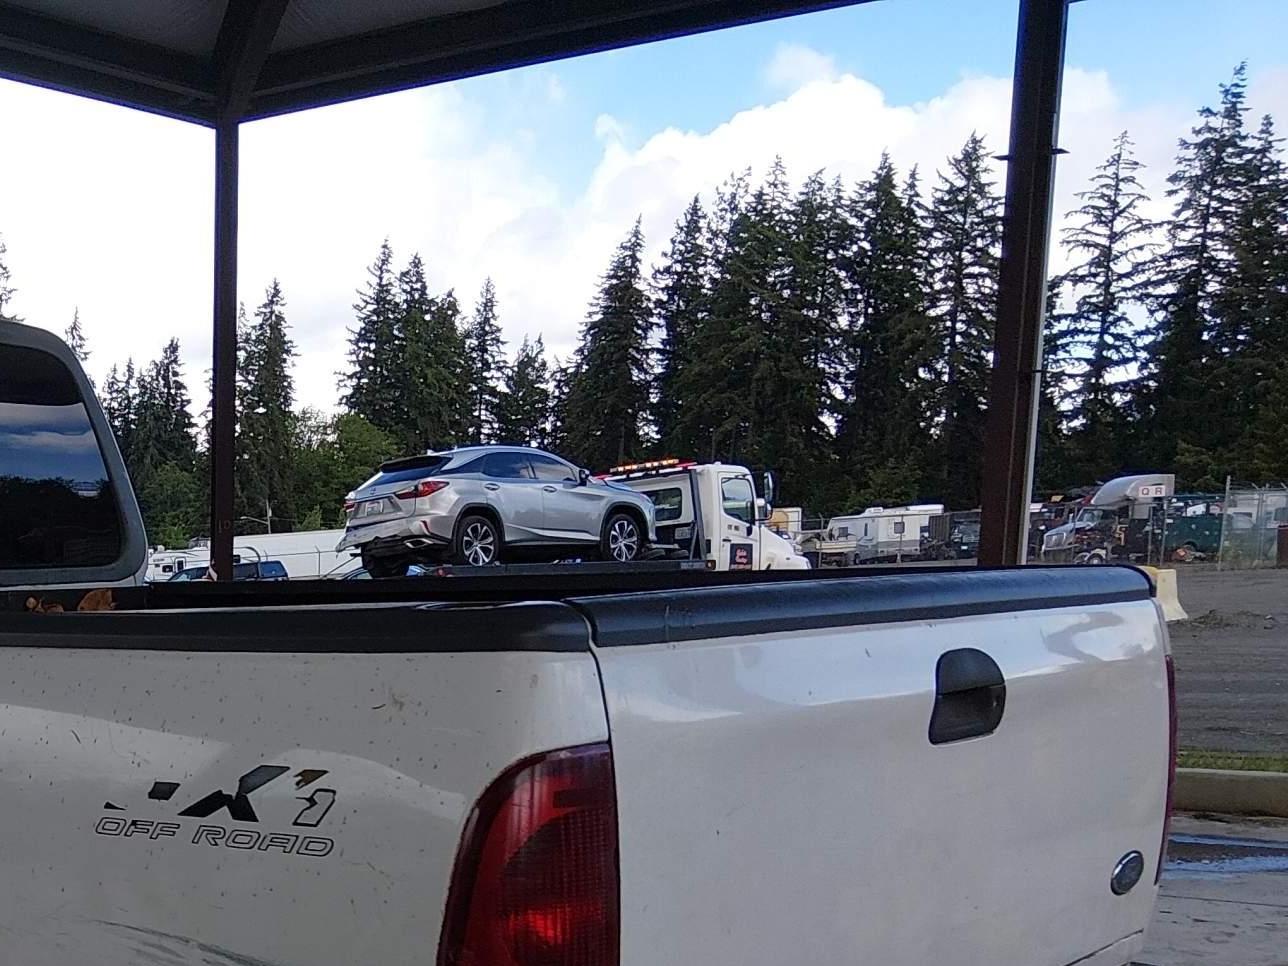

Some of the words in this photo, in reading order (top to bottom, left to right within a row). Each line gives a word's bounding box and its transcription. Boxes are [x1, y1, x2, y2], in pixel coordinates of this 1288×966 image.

[1141, 488, 1150, 496] Q
[1155, 487, 1163, 495] R
[95, 816, 181, 838] OFF
[191, 824, 335, 857] ROAD
